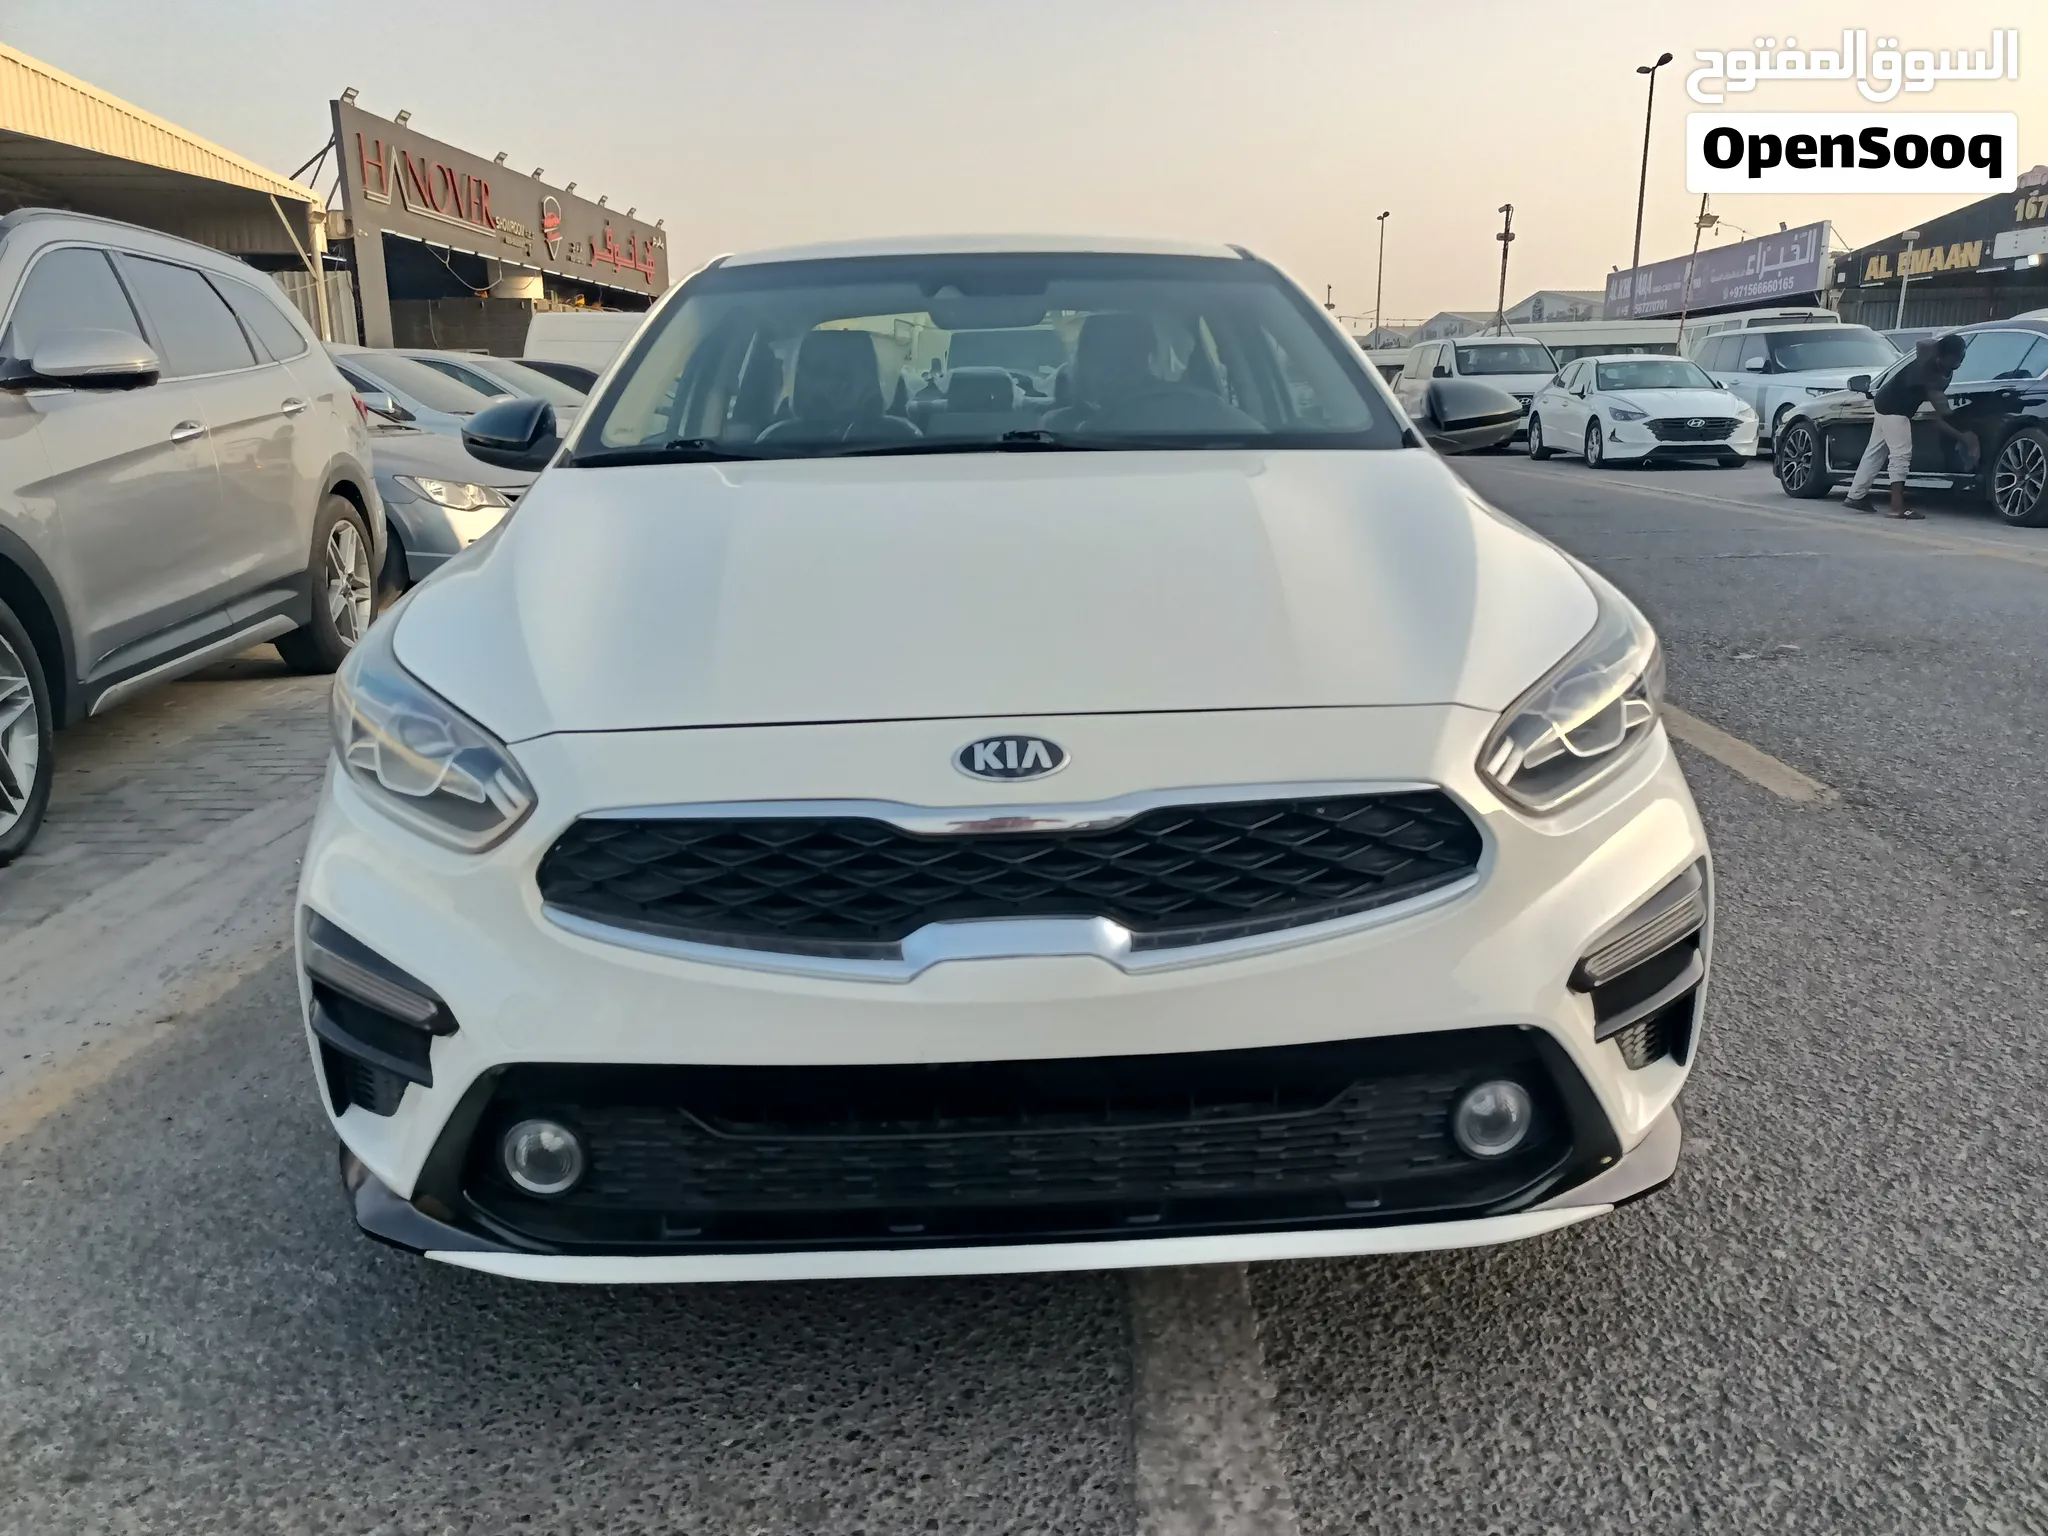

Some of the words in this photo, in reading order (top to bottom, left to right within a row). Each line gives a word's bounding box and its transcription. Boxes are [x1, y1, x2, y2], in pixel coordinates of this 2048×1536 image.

[356, 132, 494, 229] HANOVER
[1864, 255, 1892, 281] AL
[1897, 240, 1983, 276] EMAAN
[973, 740, 1053, 771] KIA
